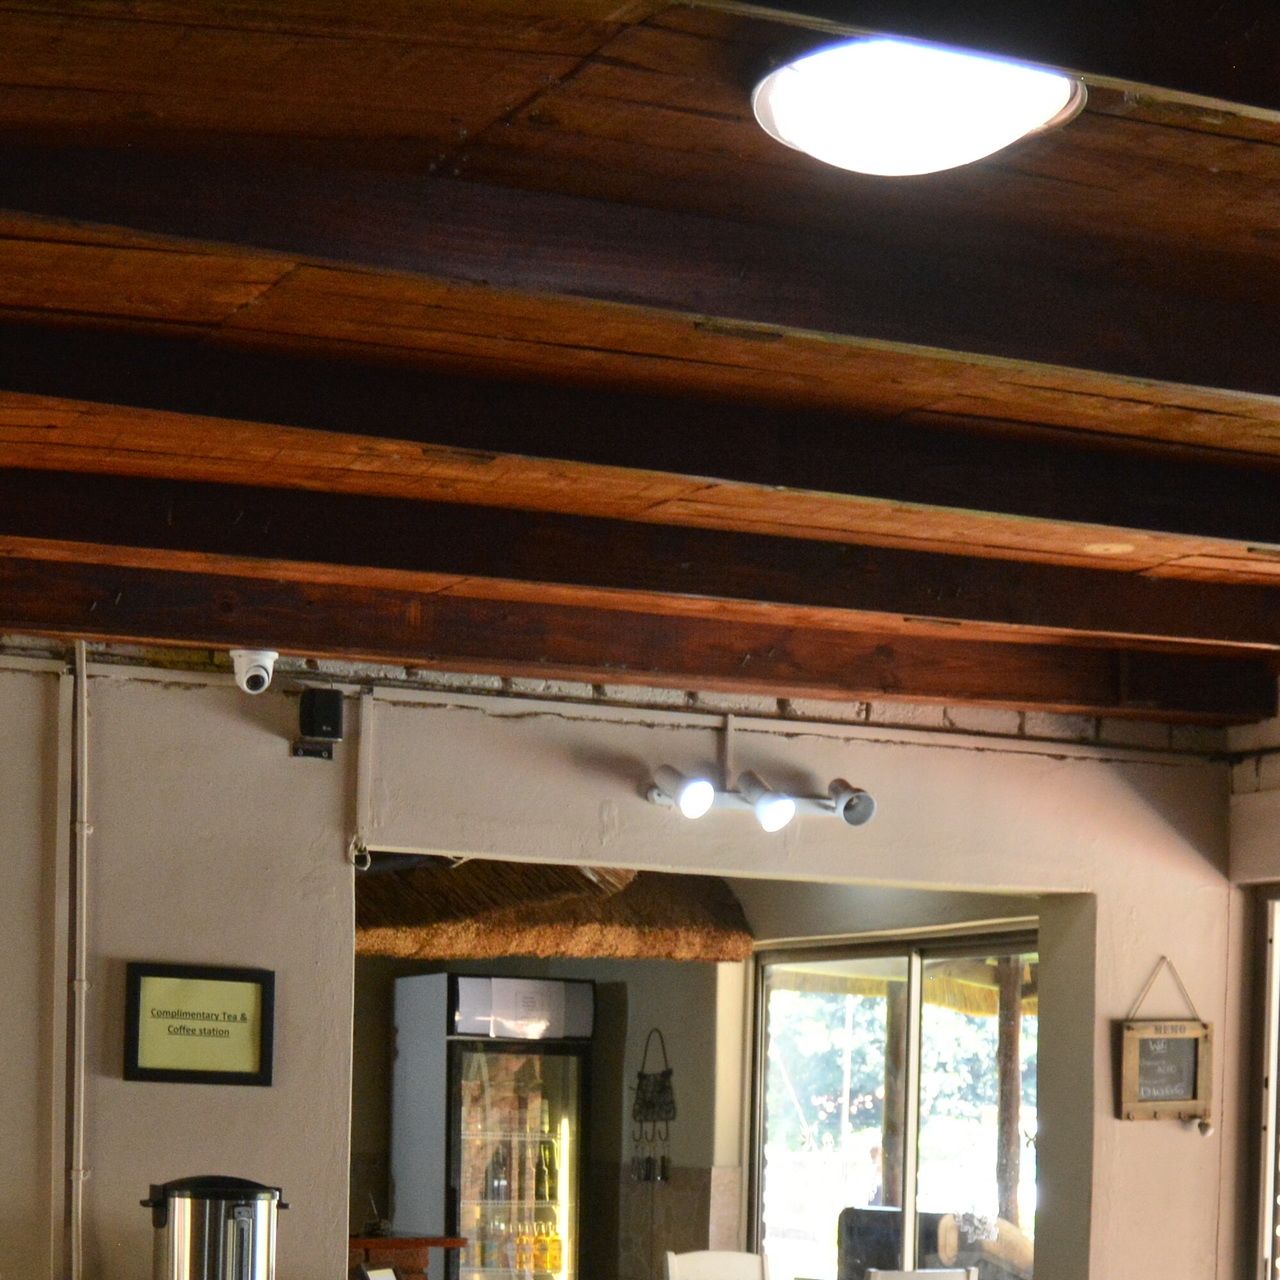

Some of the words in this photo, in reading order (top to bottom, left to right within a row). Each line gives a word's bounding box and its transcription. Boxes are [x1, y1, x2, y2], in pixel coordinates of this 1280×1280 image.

[150, 1008, 219, 1022] Complimentary
[221, 1011, 237, 1022] Tea
[240, 1012, 247, 1022] &
[167, 1025, 196, 1035] Coffee
[199, 1026, 230, 1037] station
